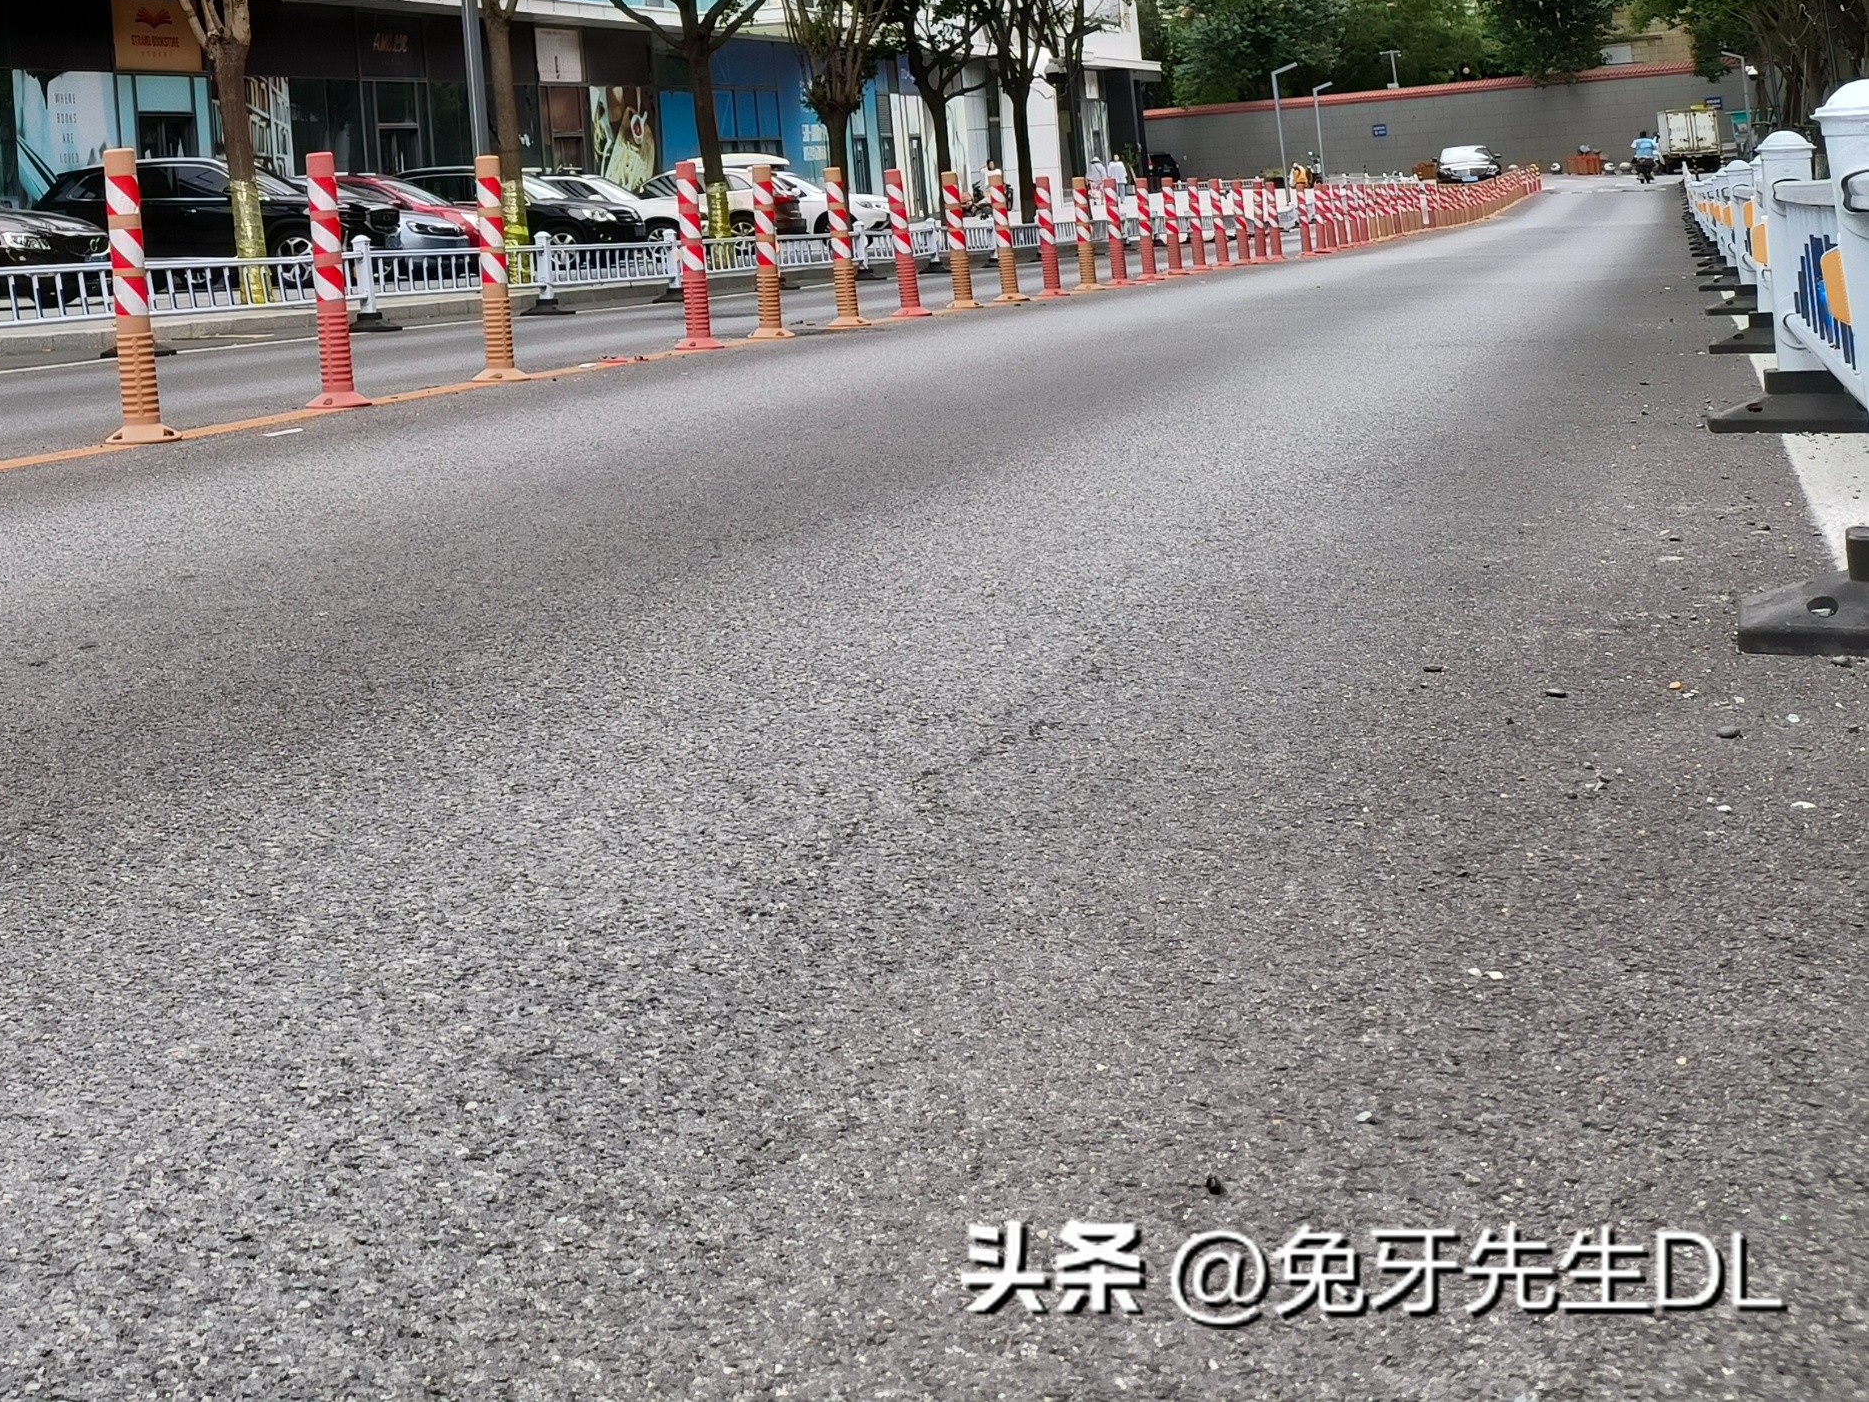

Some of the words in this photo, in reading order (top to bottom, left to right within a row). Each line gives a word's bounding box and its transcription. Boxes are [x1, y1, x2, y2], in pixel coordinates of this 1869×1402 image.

[54, 93, 76, 104] WHERE
[56, 113, 77, 124] BOOKS
[62, 132, 74, 144] ARE
[59, 152, 80, 164] LOVED
